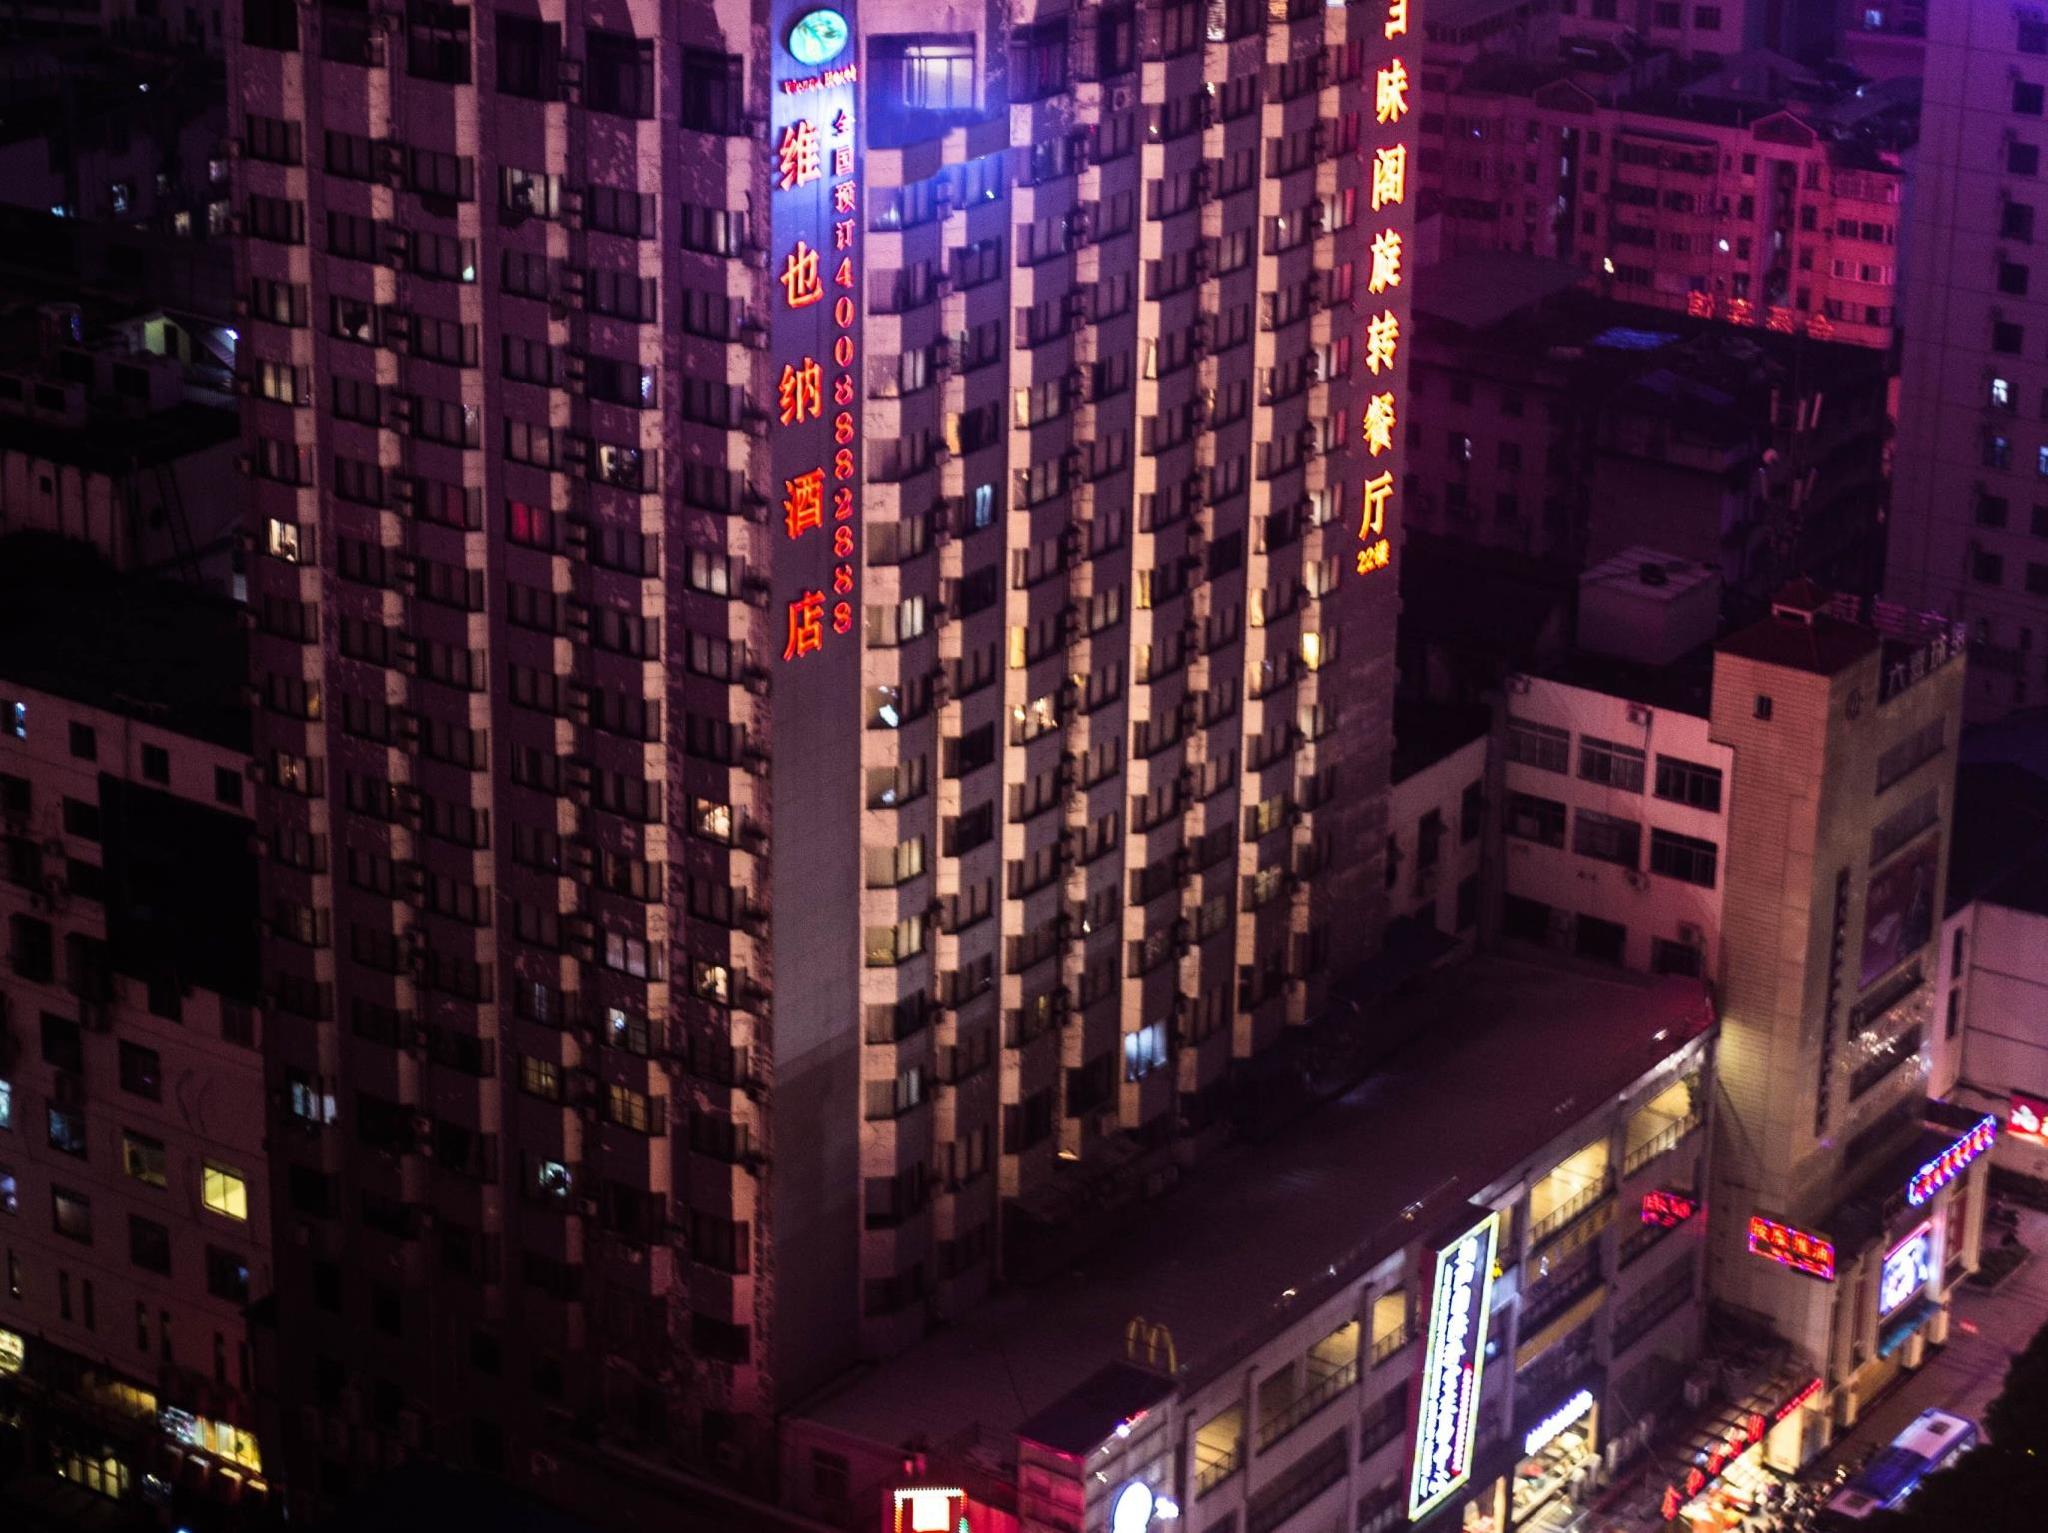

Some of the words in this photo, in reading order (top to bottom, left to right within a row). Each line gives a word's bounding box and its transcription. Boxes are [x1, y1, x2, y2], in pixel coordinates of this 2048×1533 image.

[779, 118, 826, 662] 维也纳酒店
